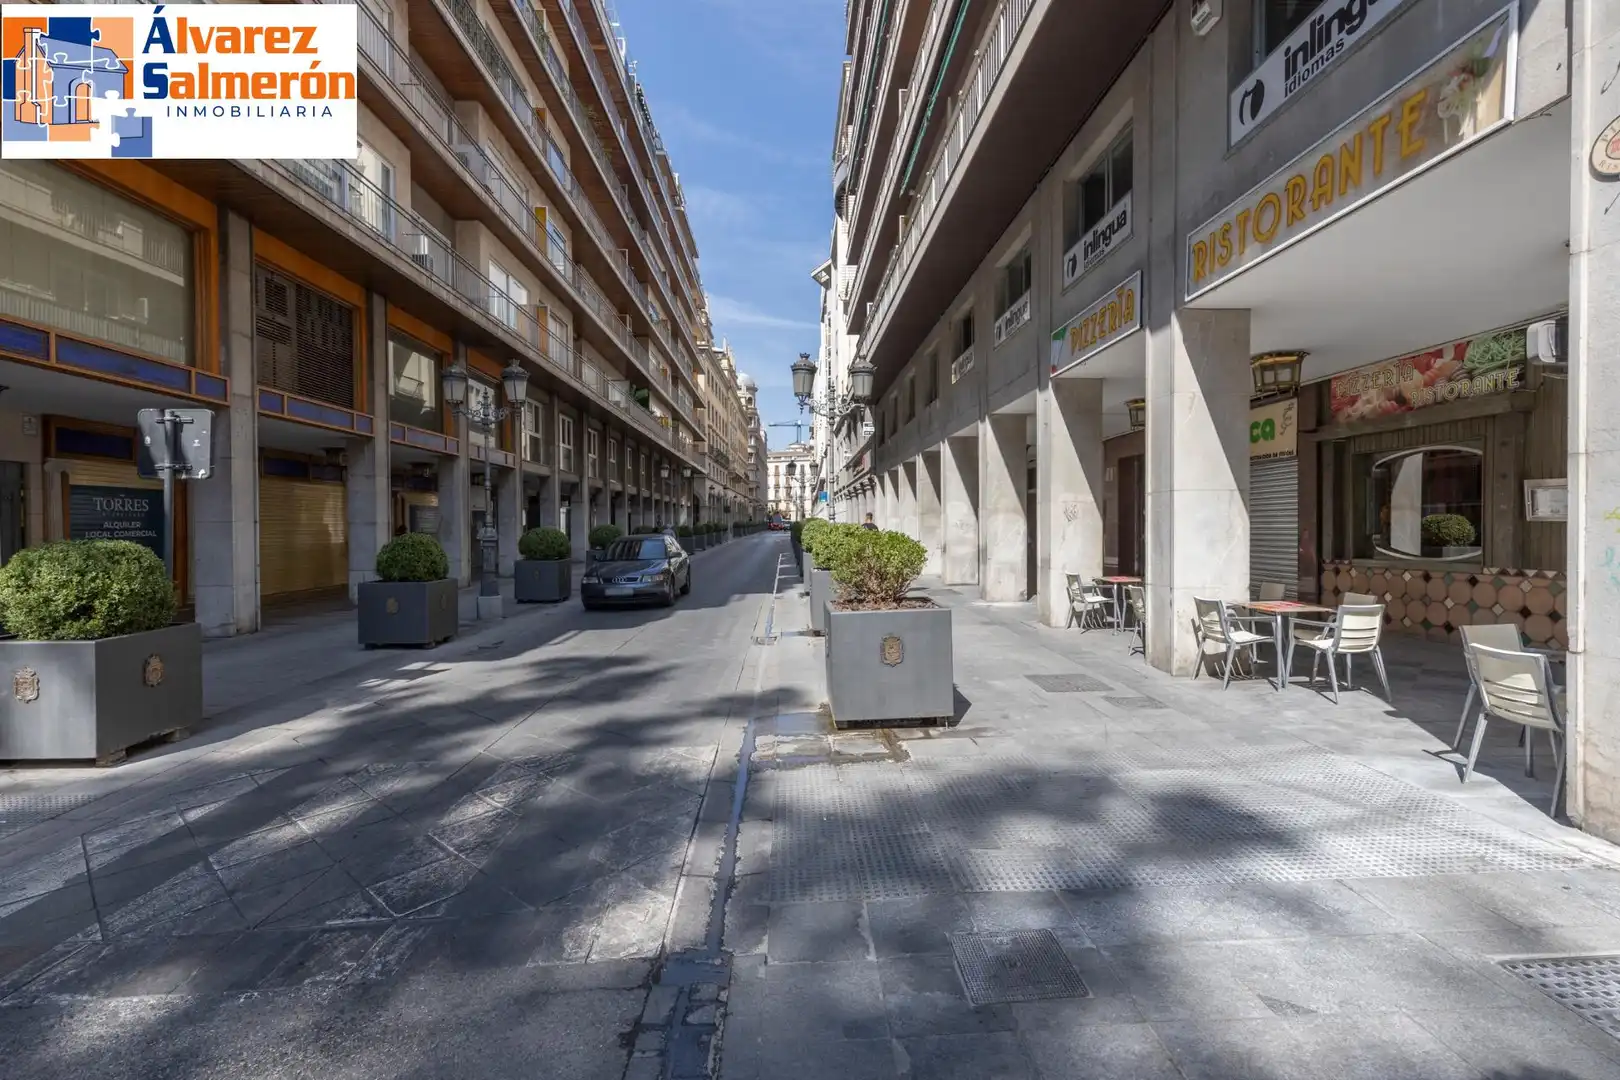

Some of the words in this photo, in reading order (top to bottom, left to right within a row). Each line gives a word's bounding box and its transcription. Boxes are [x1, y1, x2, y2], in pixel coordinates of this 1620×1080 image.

[1284, 38, 1345, 98] idiomas
[1191, 88, 1427, 283] RISTORANTE
[1083, 209, 1127, 261] inlingua
[1410, 368, 1521, 408] RISTORANTE
[93, 497, 149, 511] TORRES
[85, 531, 112, 539] LOCAL
[103, 521, 141, 530] ALQUILER
